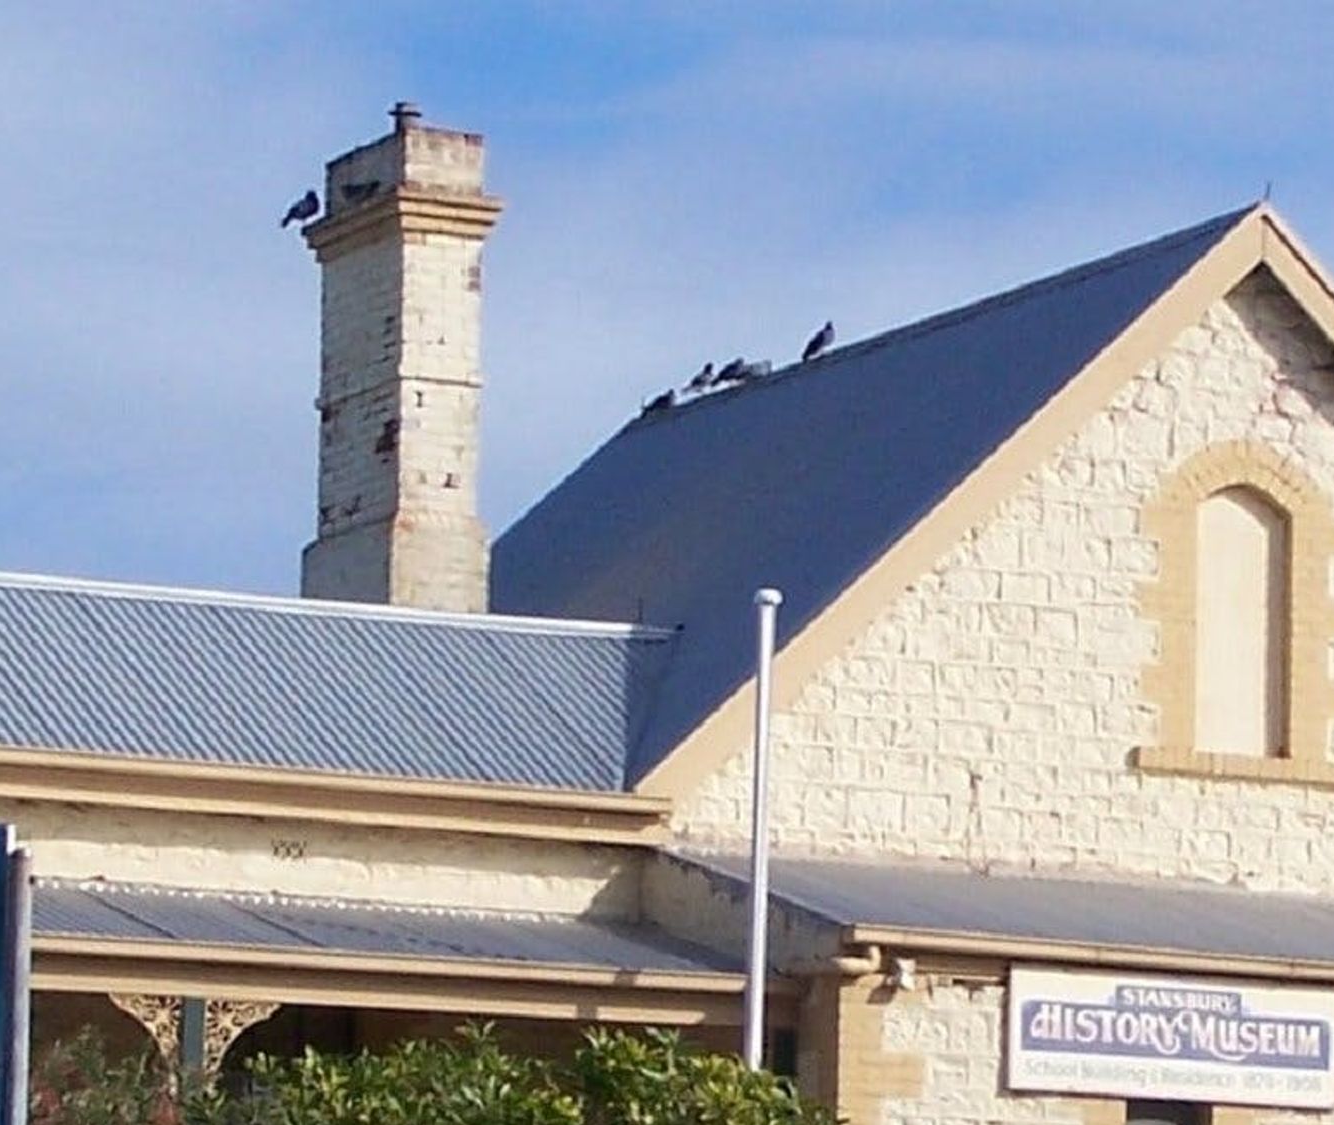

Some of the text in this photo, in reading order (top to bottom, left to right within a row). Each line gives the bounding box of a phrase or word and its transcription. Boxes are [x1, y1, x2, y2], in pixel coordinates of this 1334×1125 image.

[1121, 988, 1237, 1012] STANSBURY
[1030, 1004, 1321, 1061] HISTORY MUSEUM
